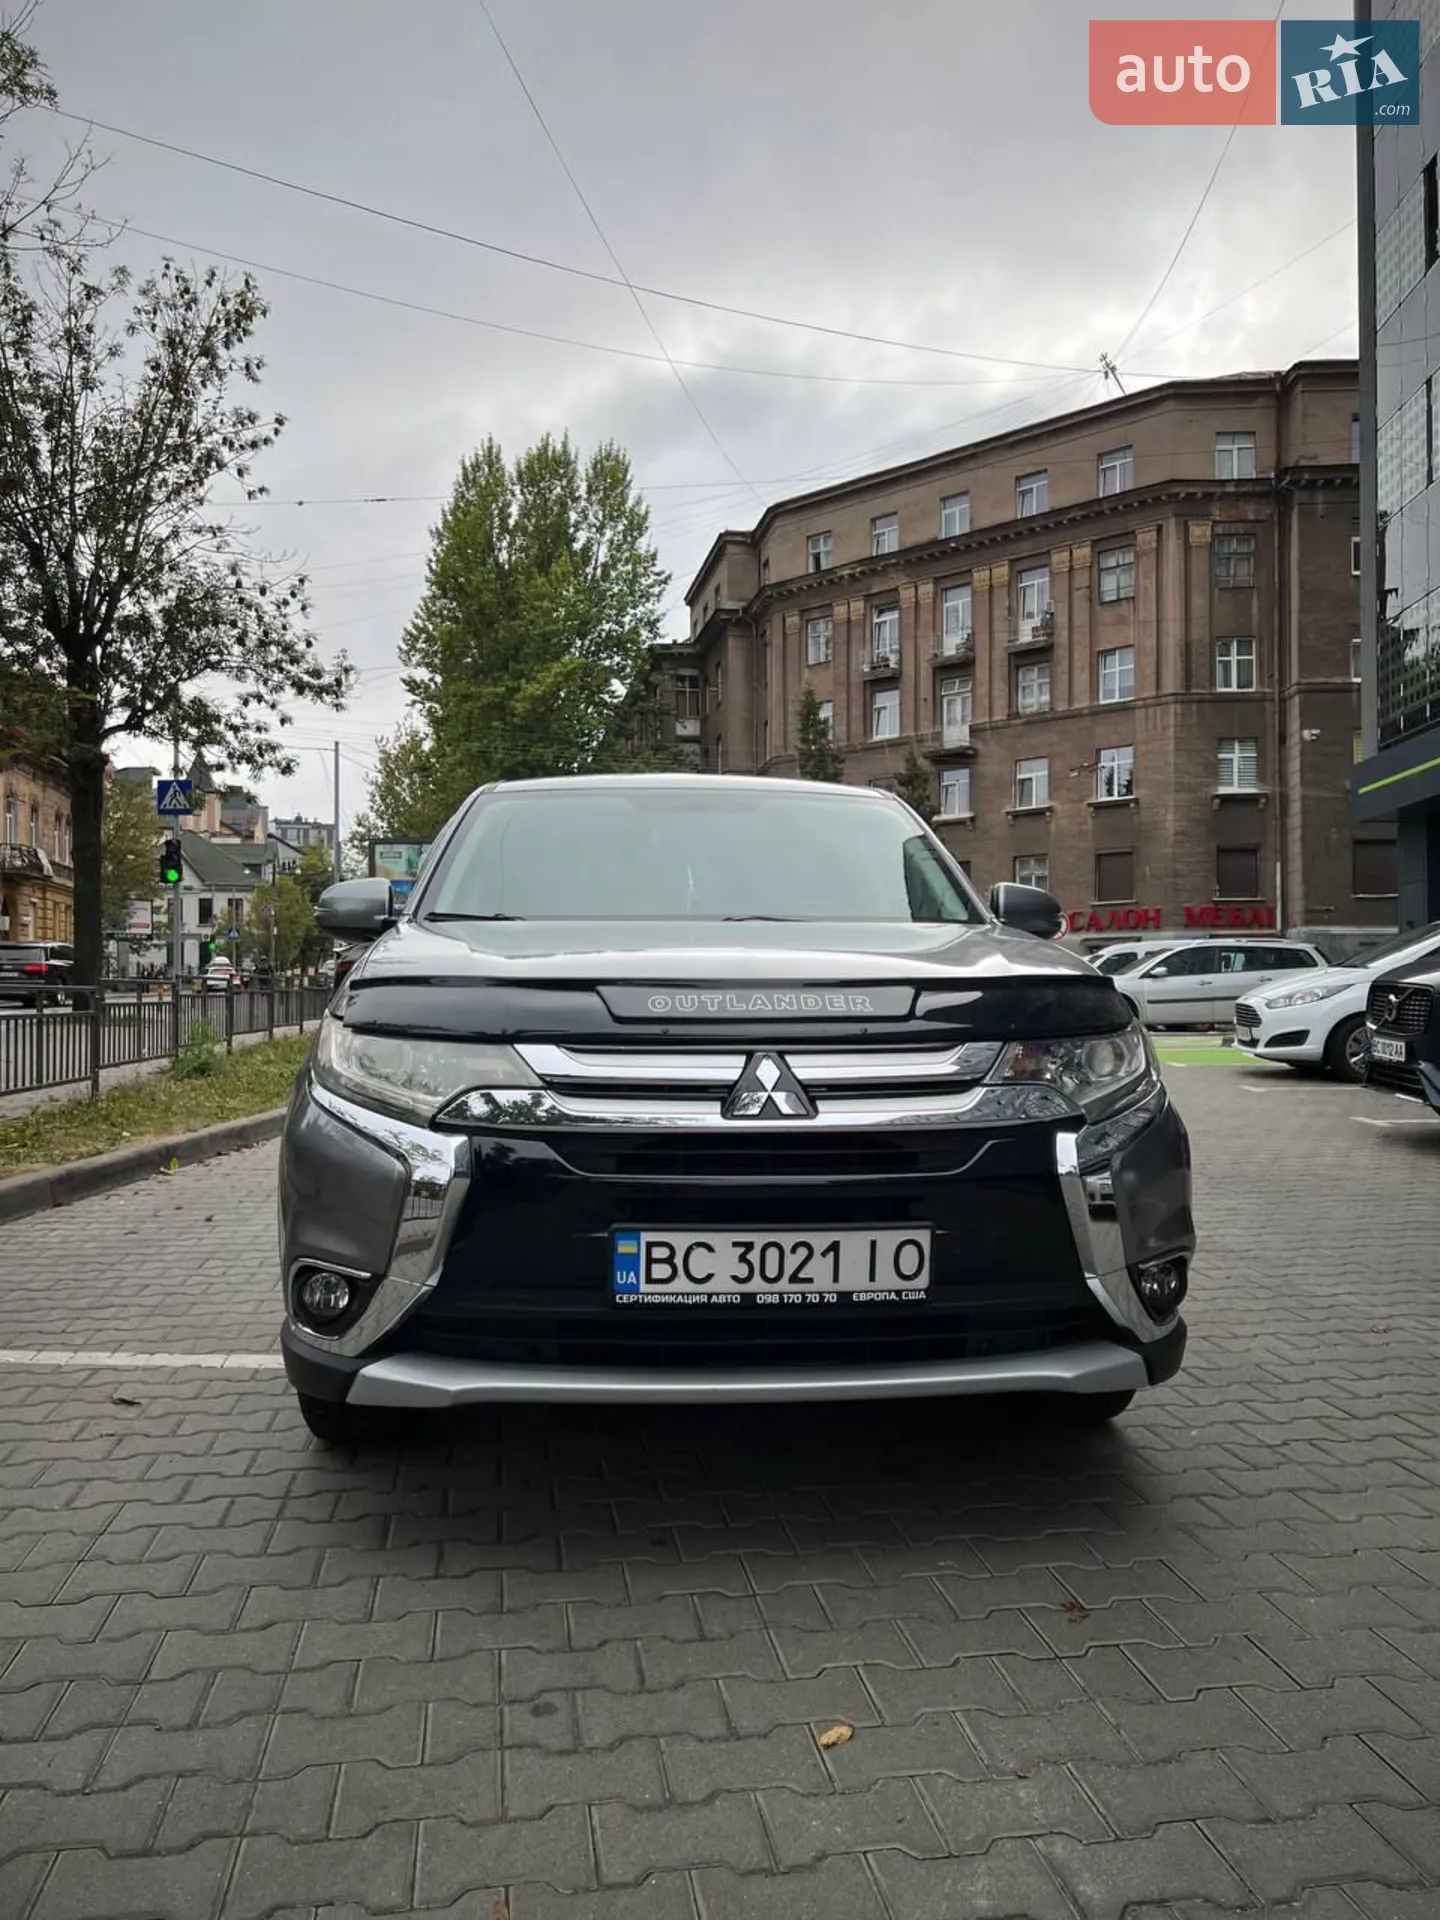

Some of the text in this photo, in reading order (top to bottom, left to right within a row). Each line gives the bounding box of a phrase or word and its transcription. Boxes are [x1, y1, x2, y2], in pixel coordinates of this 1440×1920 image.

[1068, 905, 1275, 931] САЛОН МЕБЛІ
[648, 994, 873, 1012] OUTLANDER
[644, 1240, 716, 1285] BC
[729, 1239, 840, 1285] 3021
[616, 1271, 637, 1285] UA
[615, 1294, 707, 1304] СЕРТИФИКАЦИЯ
[711, 1294, 741, 1304] АВТО
[756, 1293, 780, 1304] 098
[783, 1293, 802, 1303] 170
[805, 1293, 820, 1303] 70
[823, 1292, 837, 1303] 70
[902, 1290, 927, 1300] США
